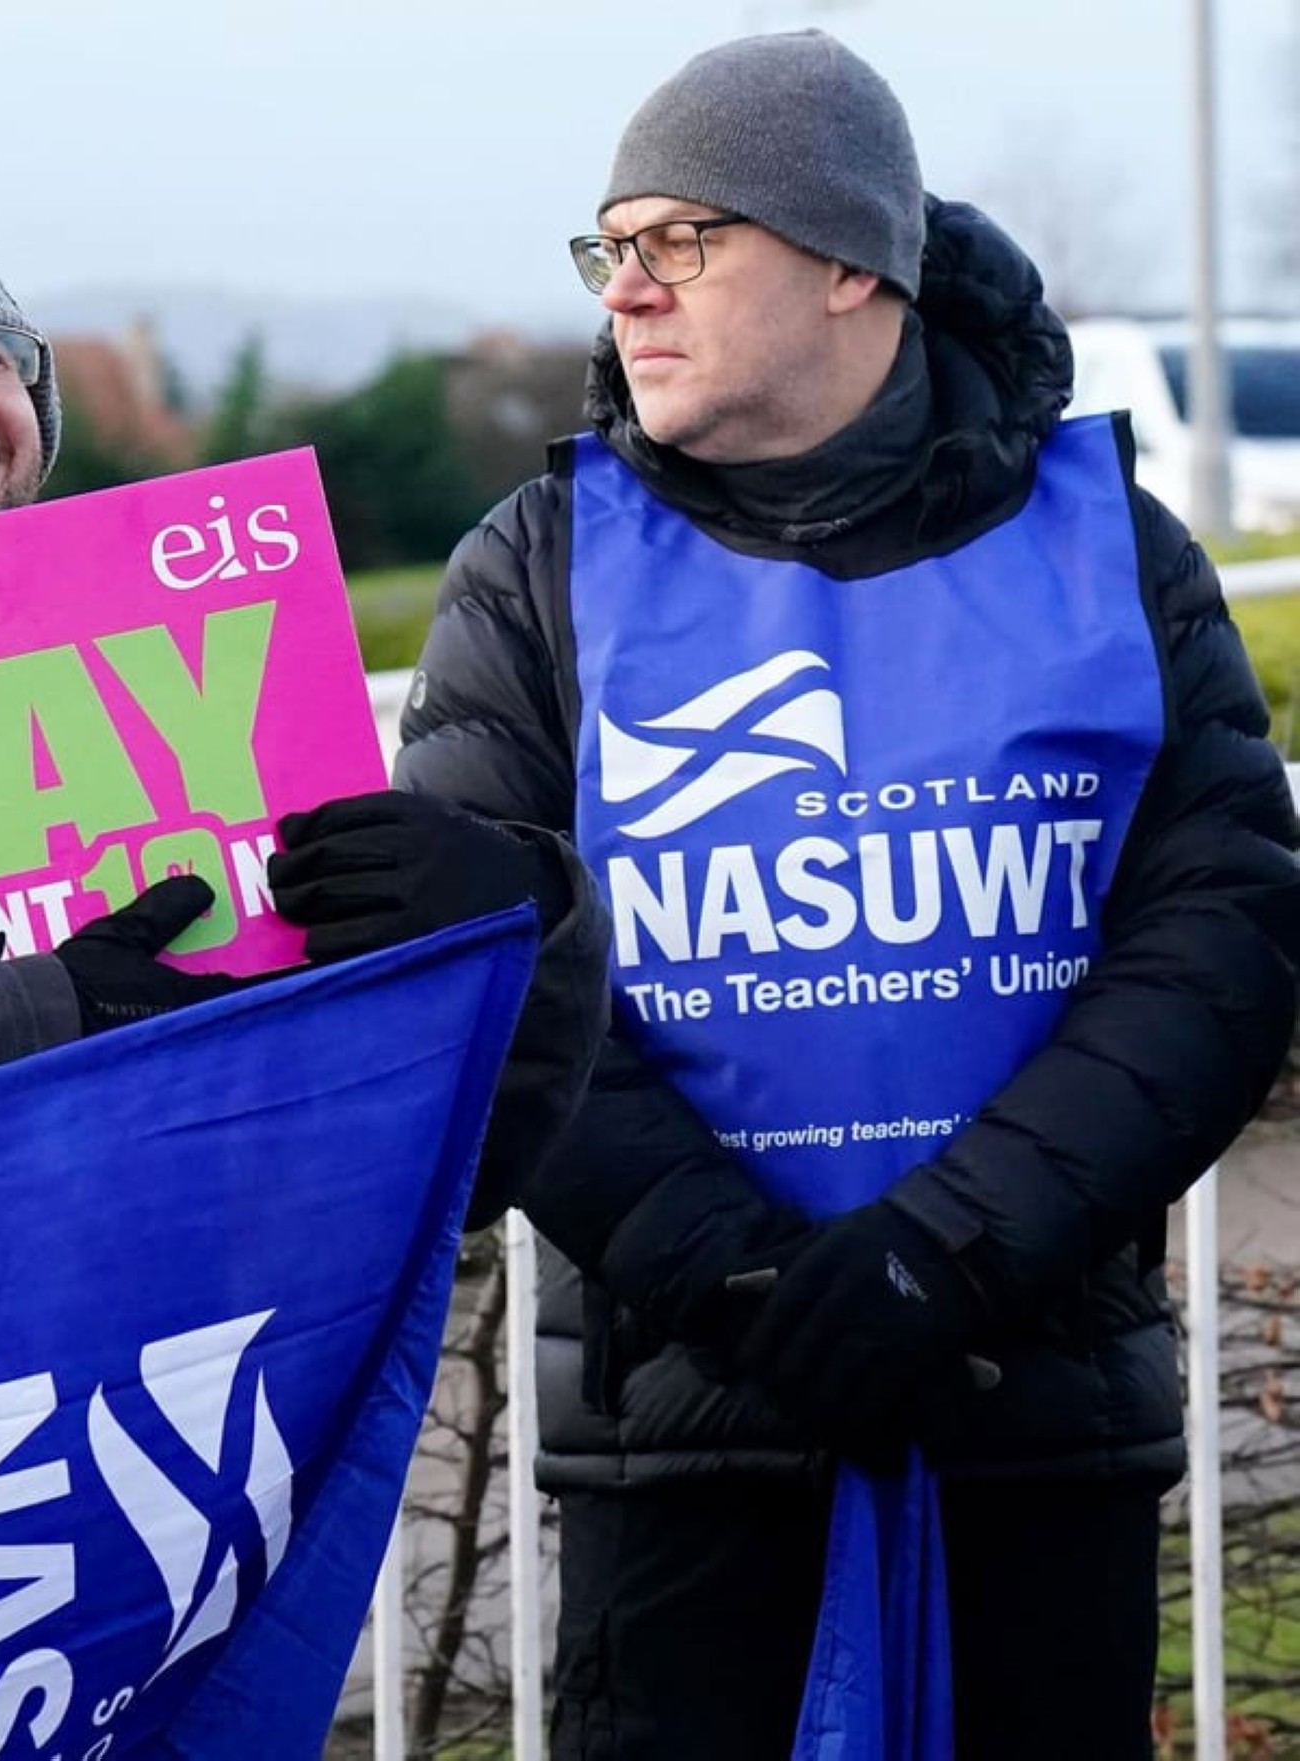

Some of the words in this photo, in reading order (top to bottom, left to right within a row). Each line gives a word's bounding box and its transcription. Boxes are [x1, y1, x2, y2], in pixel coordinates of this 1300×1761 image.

[150, 495, 300, 591] eis
[795, 772, 1099, 818] SCOTLAND
[606, 819, 1103, 968] NASUWT
[625, 981, 713, 1023] The
[989, 950, 1089, 996] Union
[752, 1124, 845, 1152] growing
